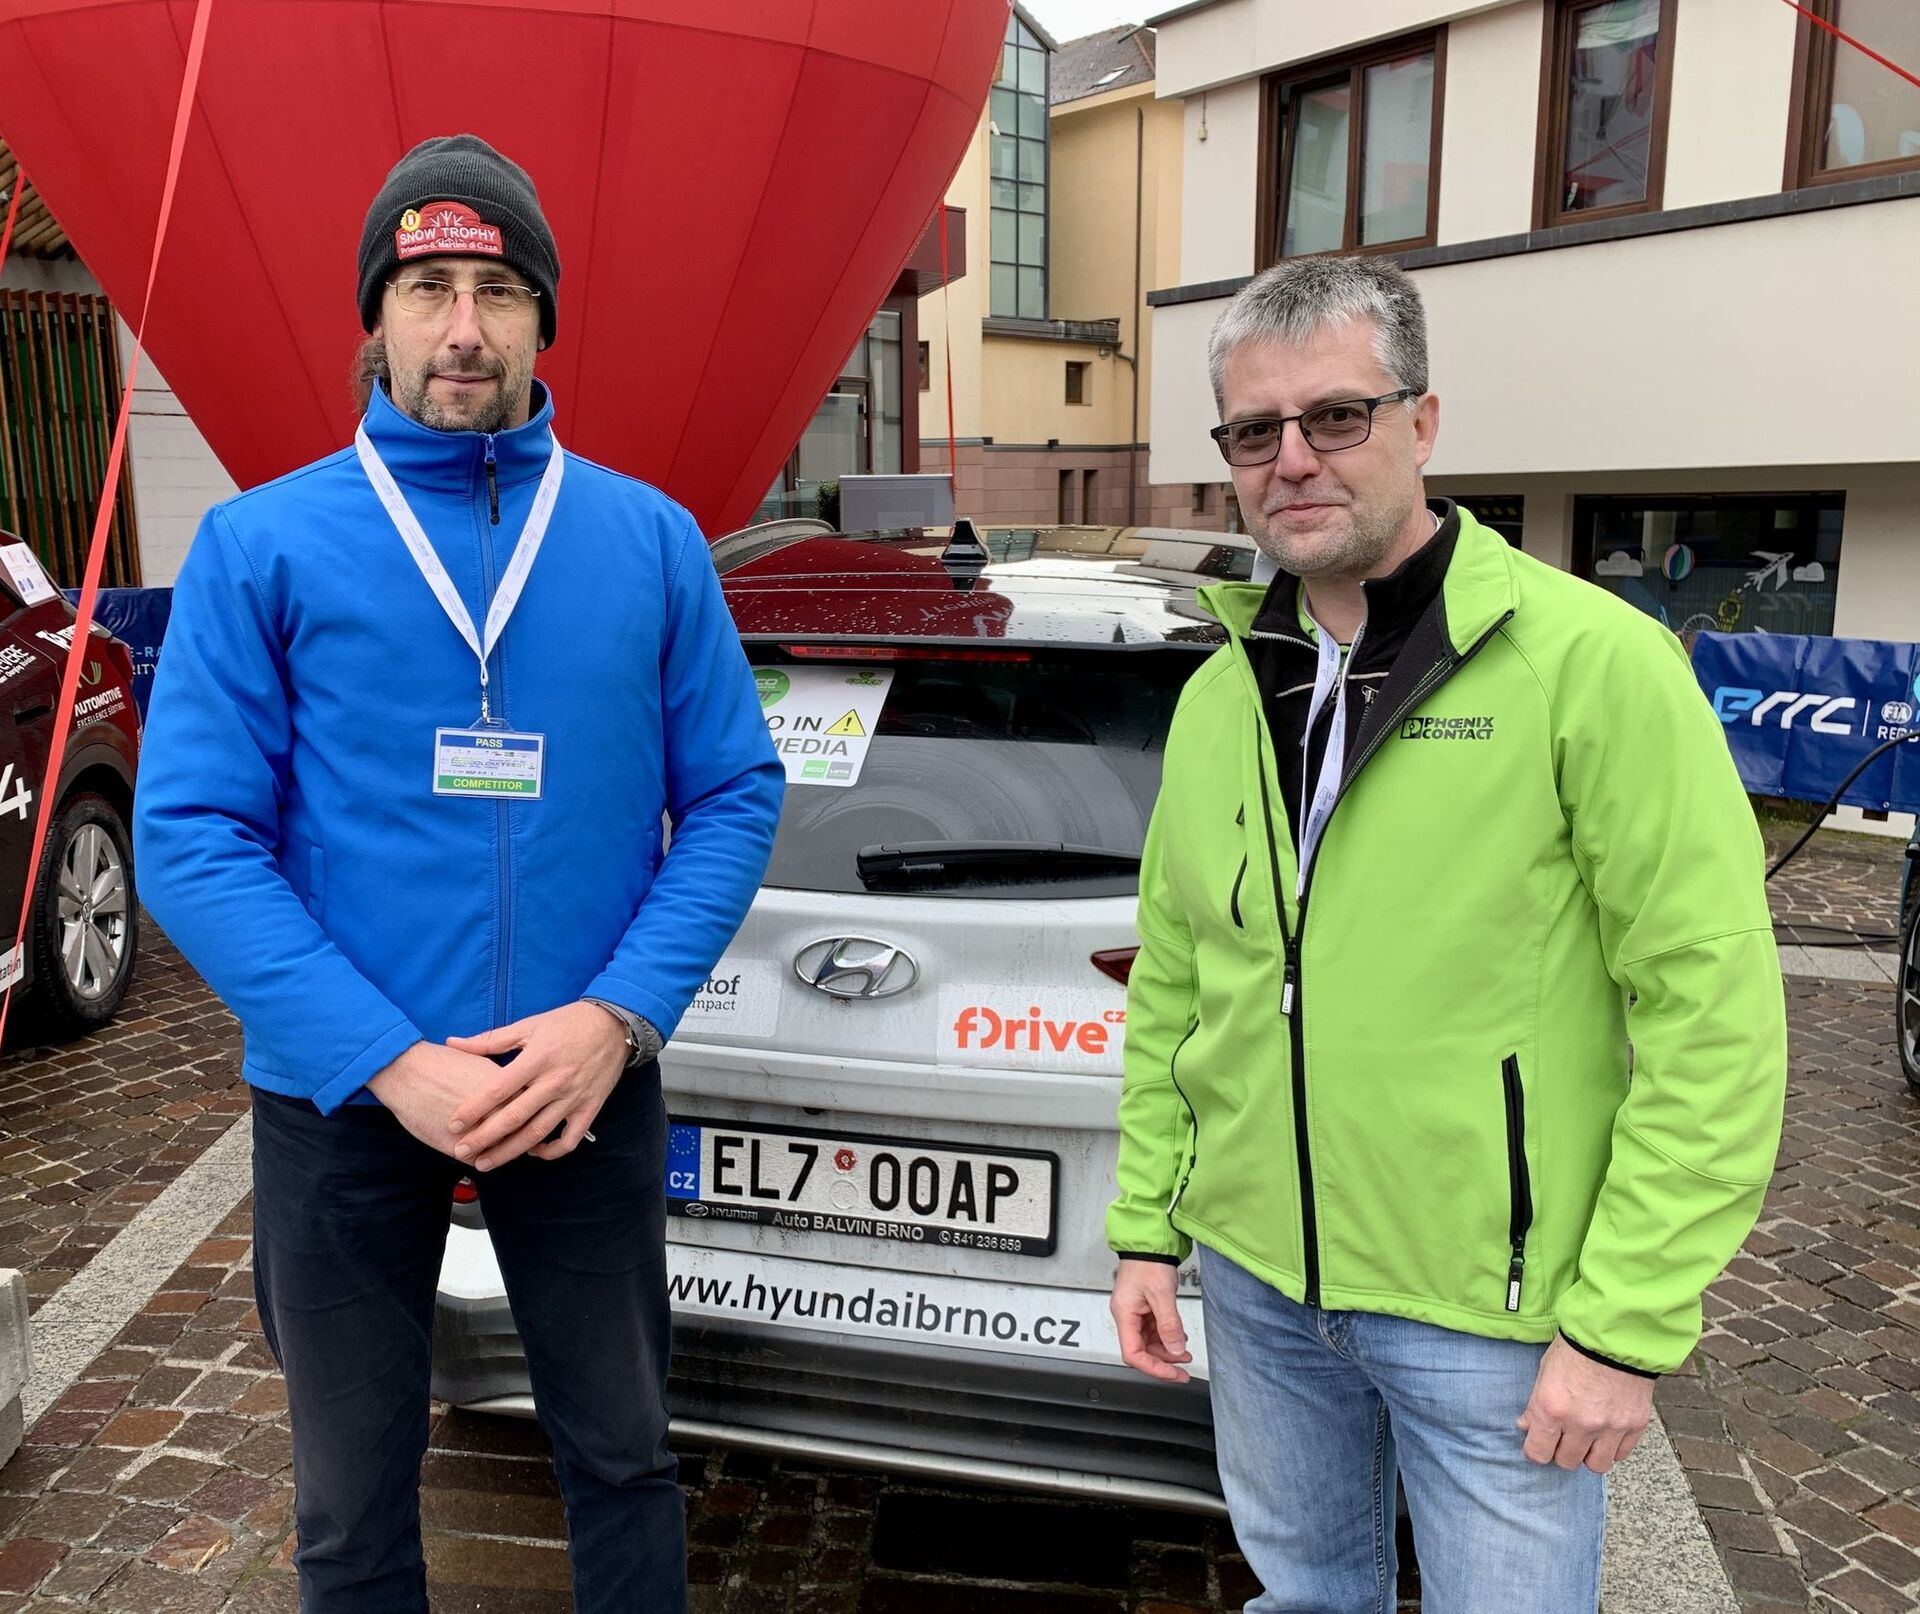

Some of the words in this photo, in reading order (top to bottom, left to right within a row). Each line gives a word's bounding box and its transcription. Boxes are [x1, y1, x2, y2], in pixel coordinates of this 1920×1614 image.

[400, 229, 436, 245] SNOW
[441, 227, 496, 241] TROPHY
[75, 686, 122, 717] AUTOMOTIVE
[77, 708, 108, 728] EXCELLENCE
[792, 716, 823, 732] IN
[475, 738, 503, 748] PASS
[1422, 729, 1494, 740] CONTACT
[453, 778, 523, 791] COMPETITOR
[690, 999, 736, 1012] mpact
[669, 1171, 695, 1190] CZ
[714, 1135, 819, 1202] EL7
[711, 1207, 759, 1220] HYUNDAI
[772, 1211, 809, 1228] Auto
[813, 1215, 872, 1235] BALVIN
[876, 1222, 924, 1241] BRNO
[952, 1232, 974, 1245] 541
[976, 1235, 998, 1249] 236
[999, 1237, 1022, 1252] 959
